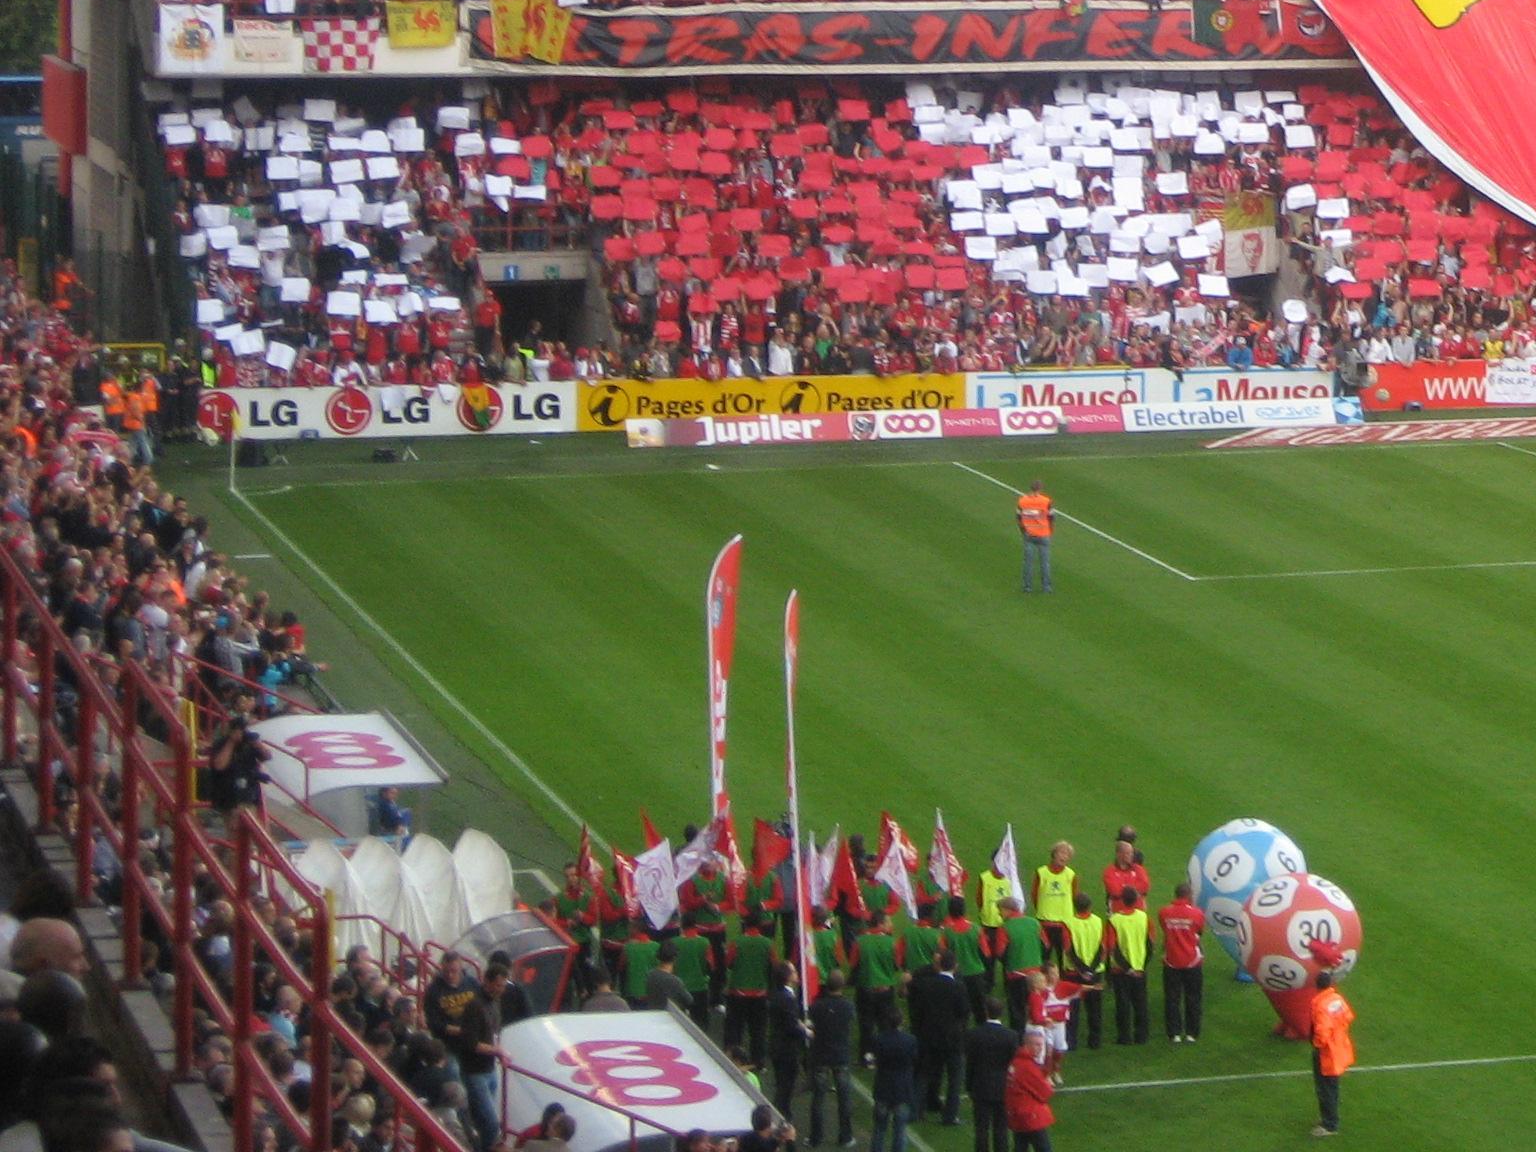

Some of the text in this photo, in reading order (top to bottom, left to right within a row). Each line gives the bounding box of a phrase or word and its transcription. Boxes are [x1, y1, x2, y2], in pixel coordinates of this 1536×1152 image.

[249, 399, 298, 427] LG
[513, 393, 561, 420] LG
[636, 392, 766, 417] Pages d'Or
[827, 388, 955, 411] Pages d'Or
[1135, 405, 1245, 428] Electrabel
[695, 415, 823, 446] Jupiler
[1258, 880, 1288, 908] 30
